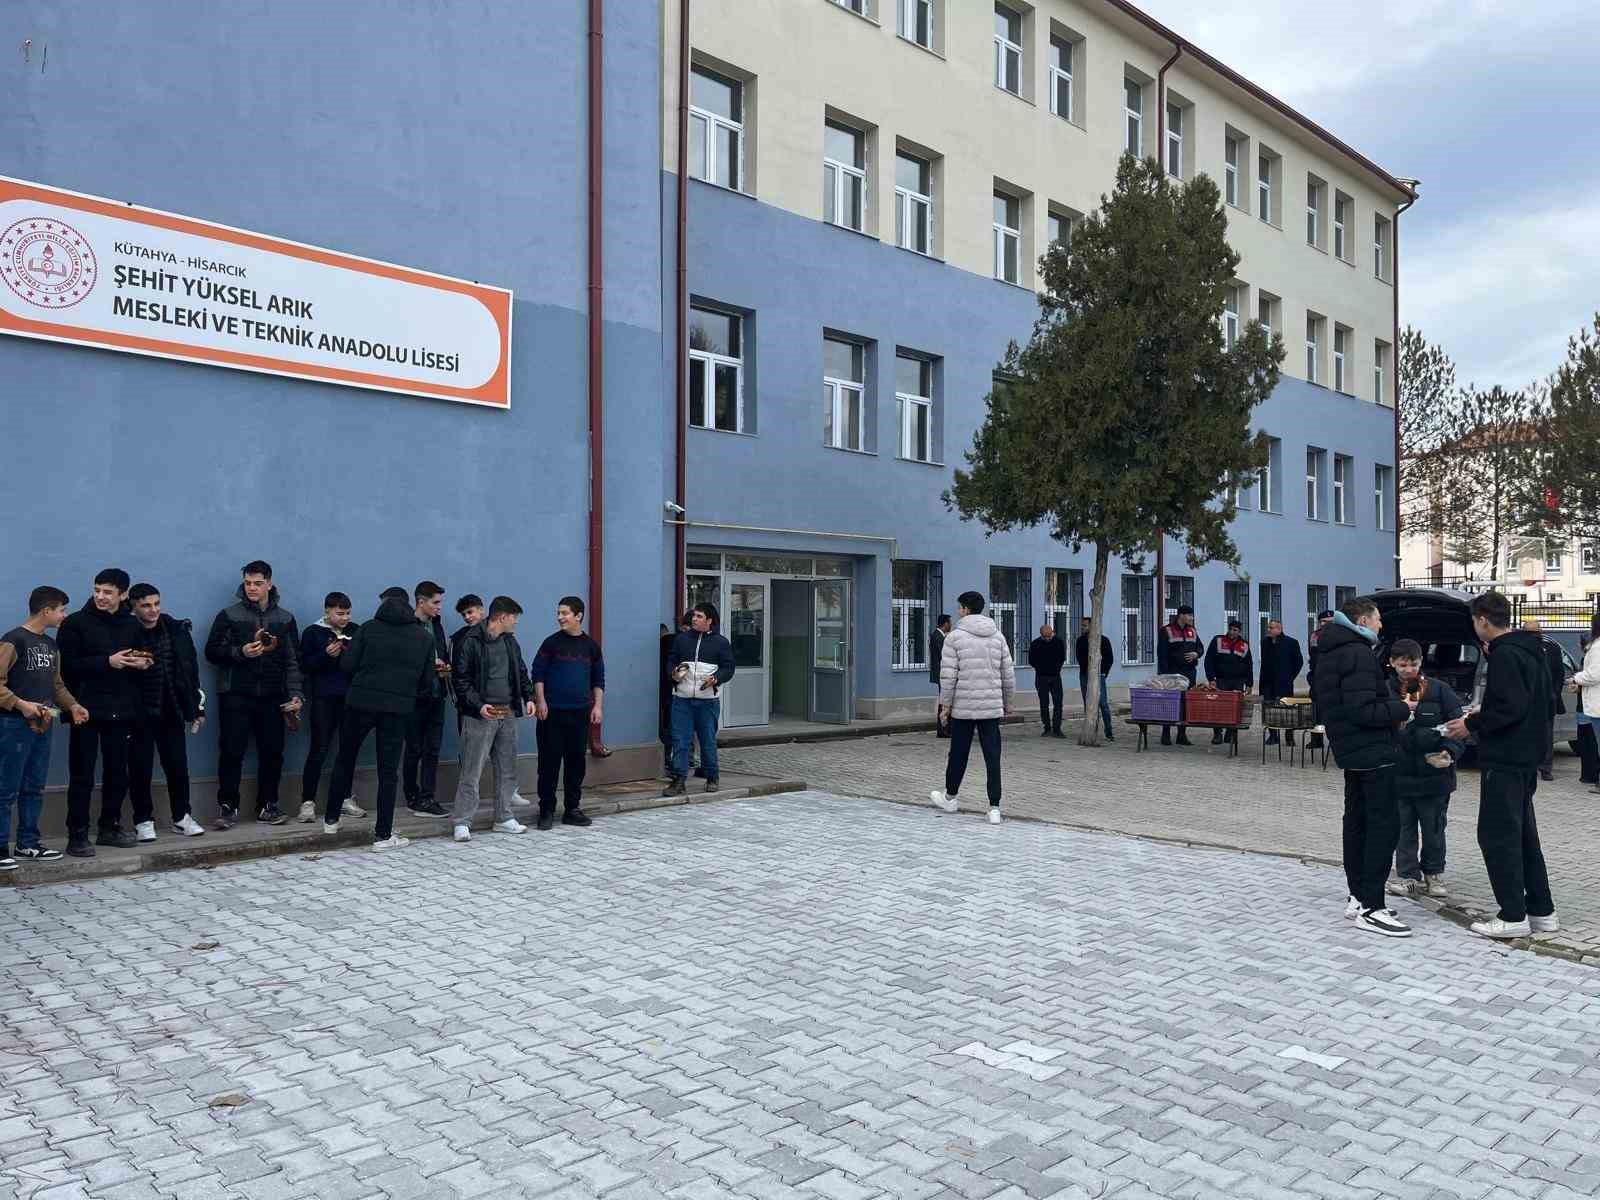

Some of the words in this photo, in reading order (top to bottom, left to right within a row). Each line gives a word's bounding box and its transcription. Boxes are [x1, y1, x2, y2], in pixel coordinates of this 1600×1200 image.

[114, 242, 177, 264] KÜTAHYA
[187, 256, 247, 278] HİSARCIK
[113, 264, 178, 293] ŞEHİT
[182, 276, 262, 310] YÜKSEL
[267, 294, 313, 320] ARIK
[113, 295, 207, 330] MESLEKİ
[211, 313, 238, 335] VE
[242, 319, 314, 348] TEKNİK
[318, 334, 408, 363] ANADOLU
[412, 347, 459, 372] LİSESİ
